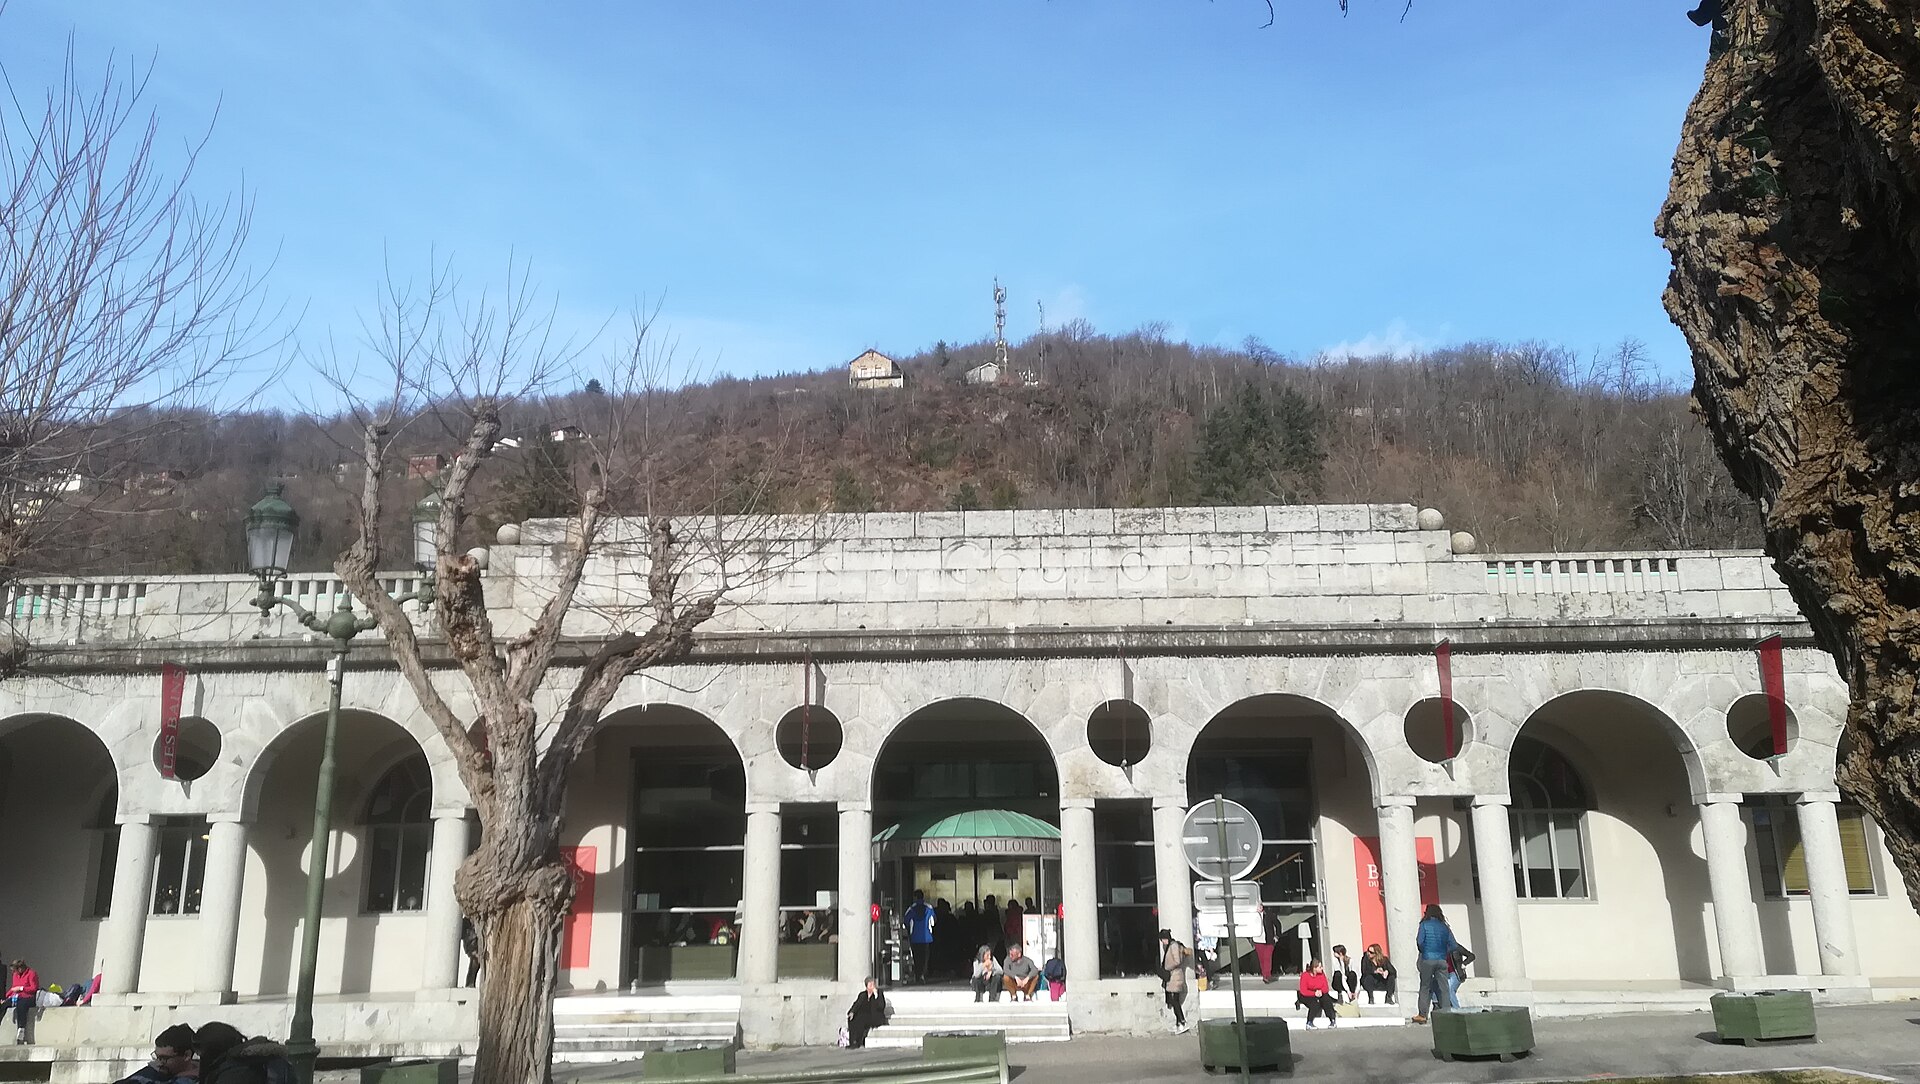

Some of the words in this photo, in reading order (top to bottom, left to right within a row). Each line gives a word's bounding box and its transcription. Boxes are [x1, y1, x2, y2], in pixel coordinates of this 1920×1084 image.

[168, 670, 182, 728] BAINS
[164, 735, 175, 769] LES
[952, 841, 969, 854] DU
[973, 839, 1057, 854] COULOUBRET
